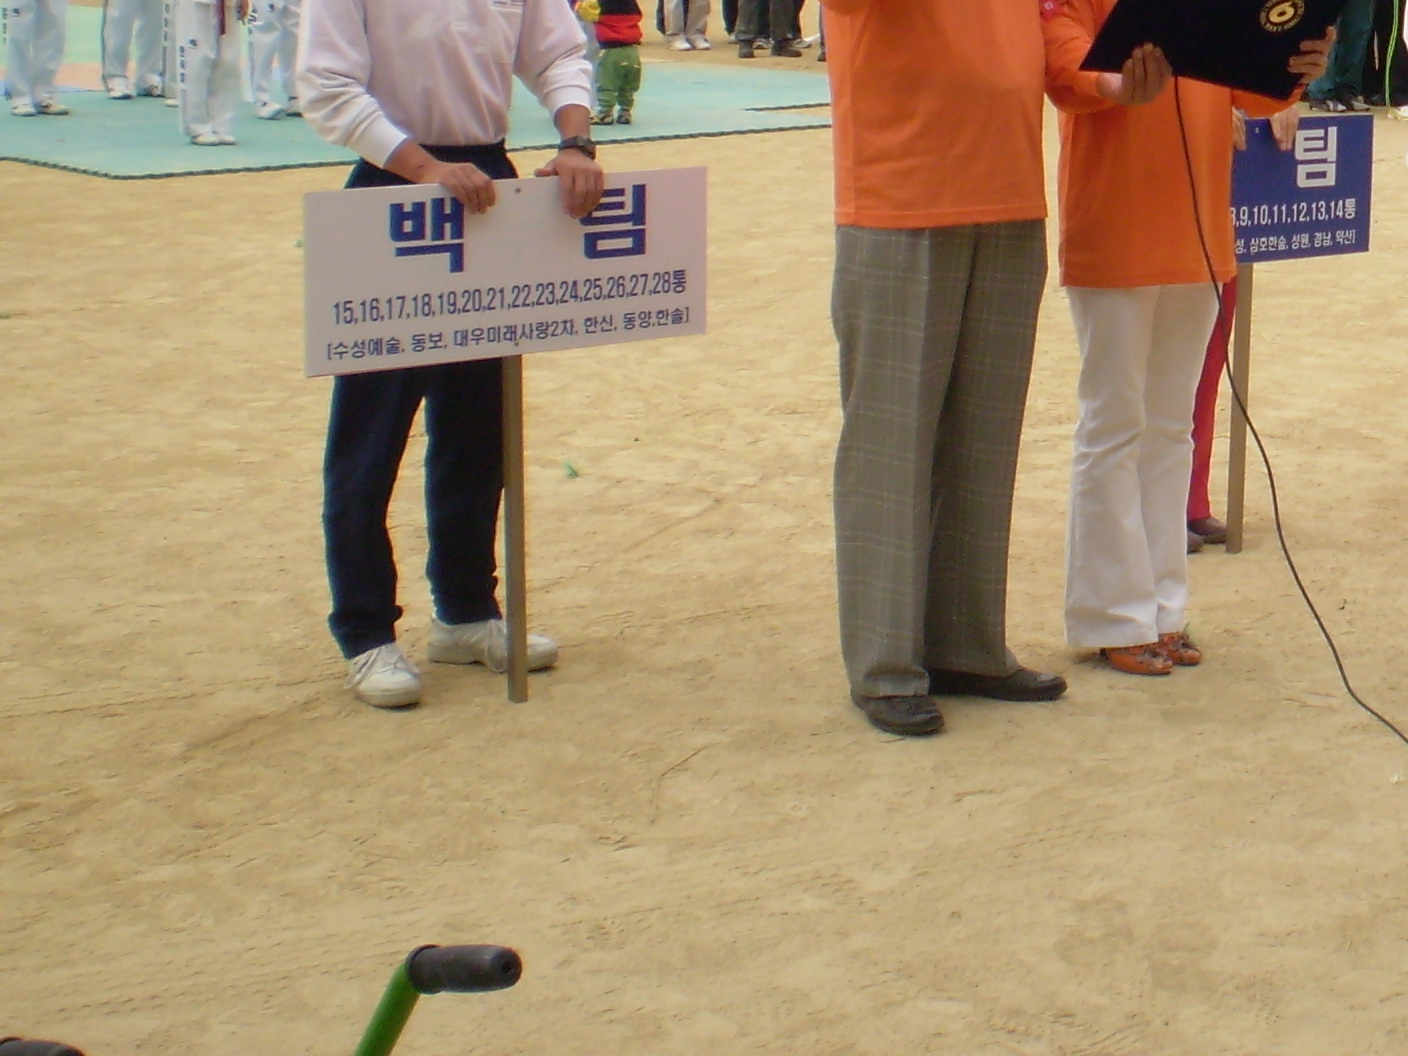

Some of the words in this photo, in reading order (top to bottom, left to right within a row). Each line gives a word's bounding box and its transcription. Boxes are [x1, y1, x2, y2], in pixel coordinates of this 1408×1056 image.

[1295, 126, 1338, 188] 팀
[389, 196, 465, 274] 백
[579, 183, 647, 260] 팀
